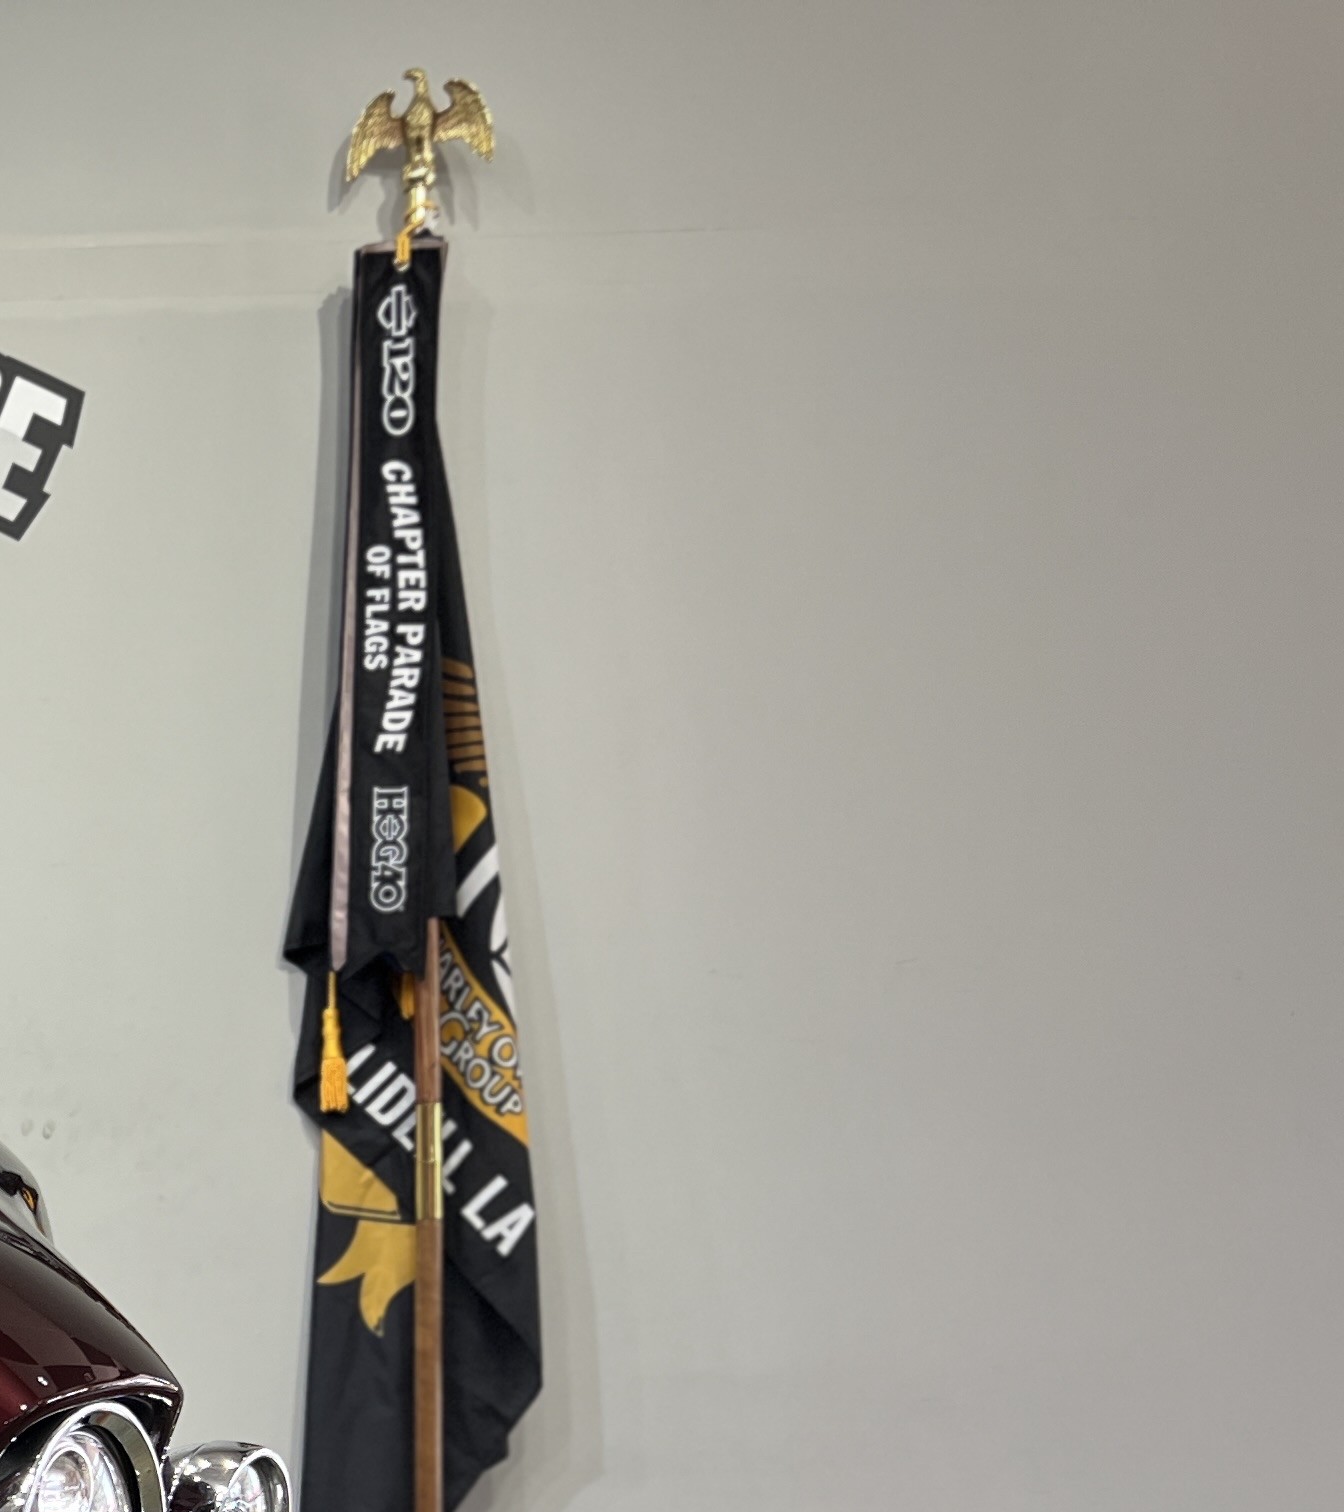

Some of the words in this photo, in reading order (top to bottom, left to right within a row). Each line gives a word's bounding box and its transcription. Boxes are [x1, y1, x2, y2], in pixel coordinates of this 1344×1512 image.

[382, 337, 416, 436] 120
[366, 545, 392, 579] OF
[380, 459, 427, 612] CHAPTER
[363, 587, 391, 671] FLAGS
[373, 624, 426, 754] PARADE
[439, 938, 503, 1041] ARLEY
[439, 1011, 523, 1115] GROUP
[461, 1174, 535, 1256] LA
